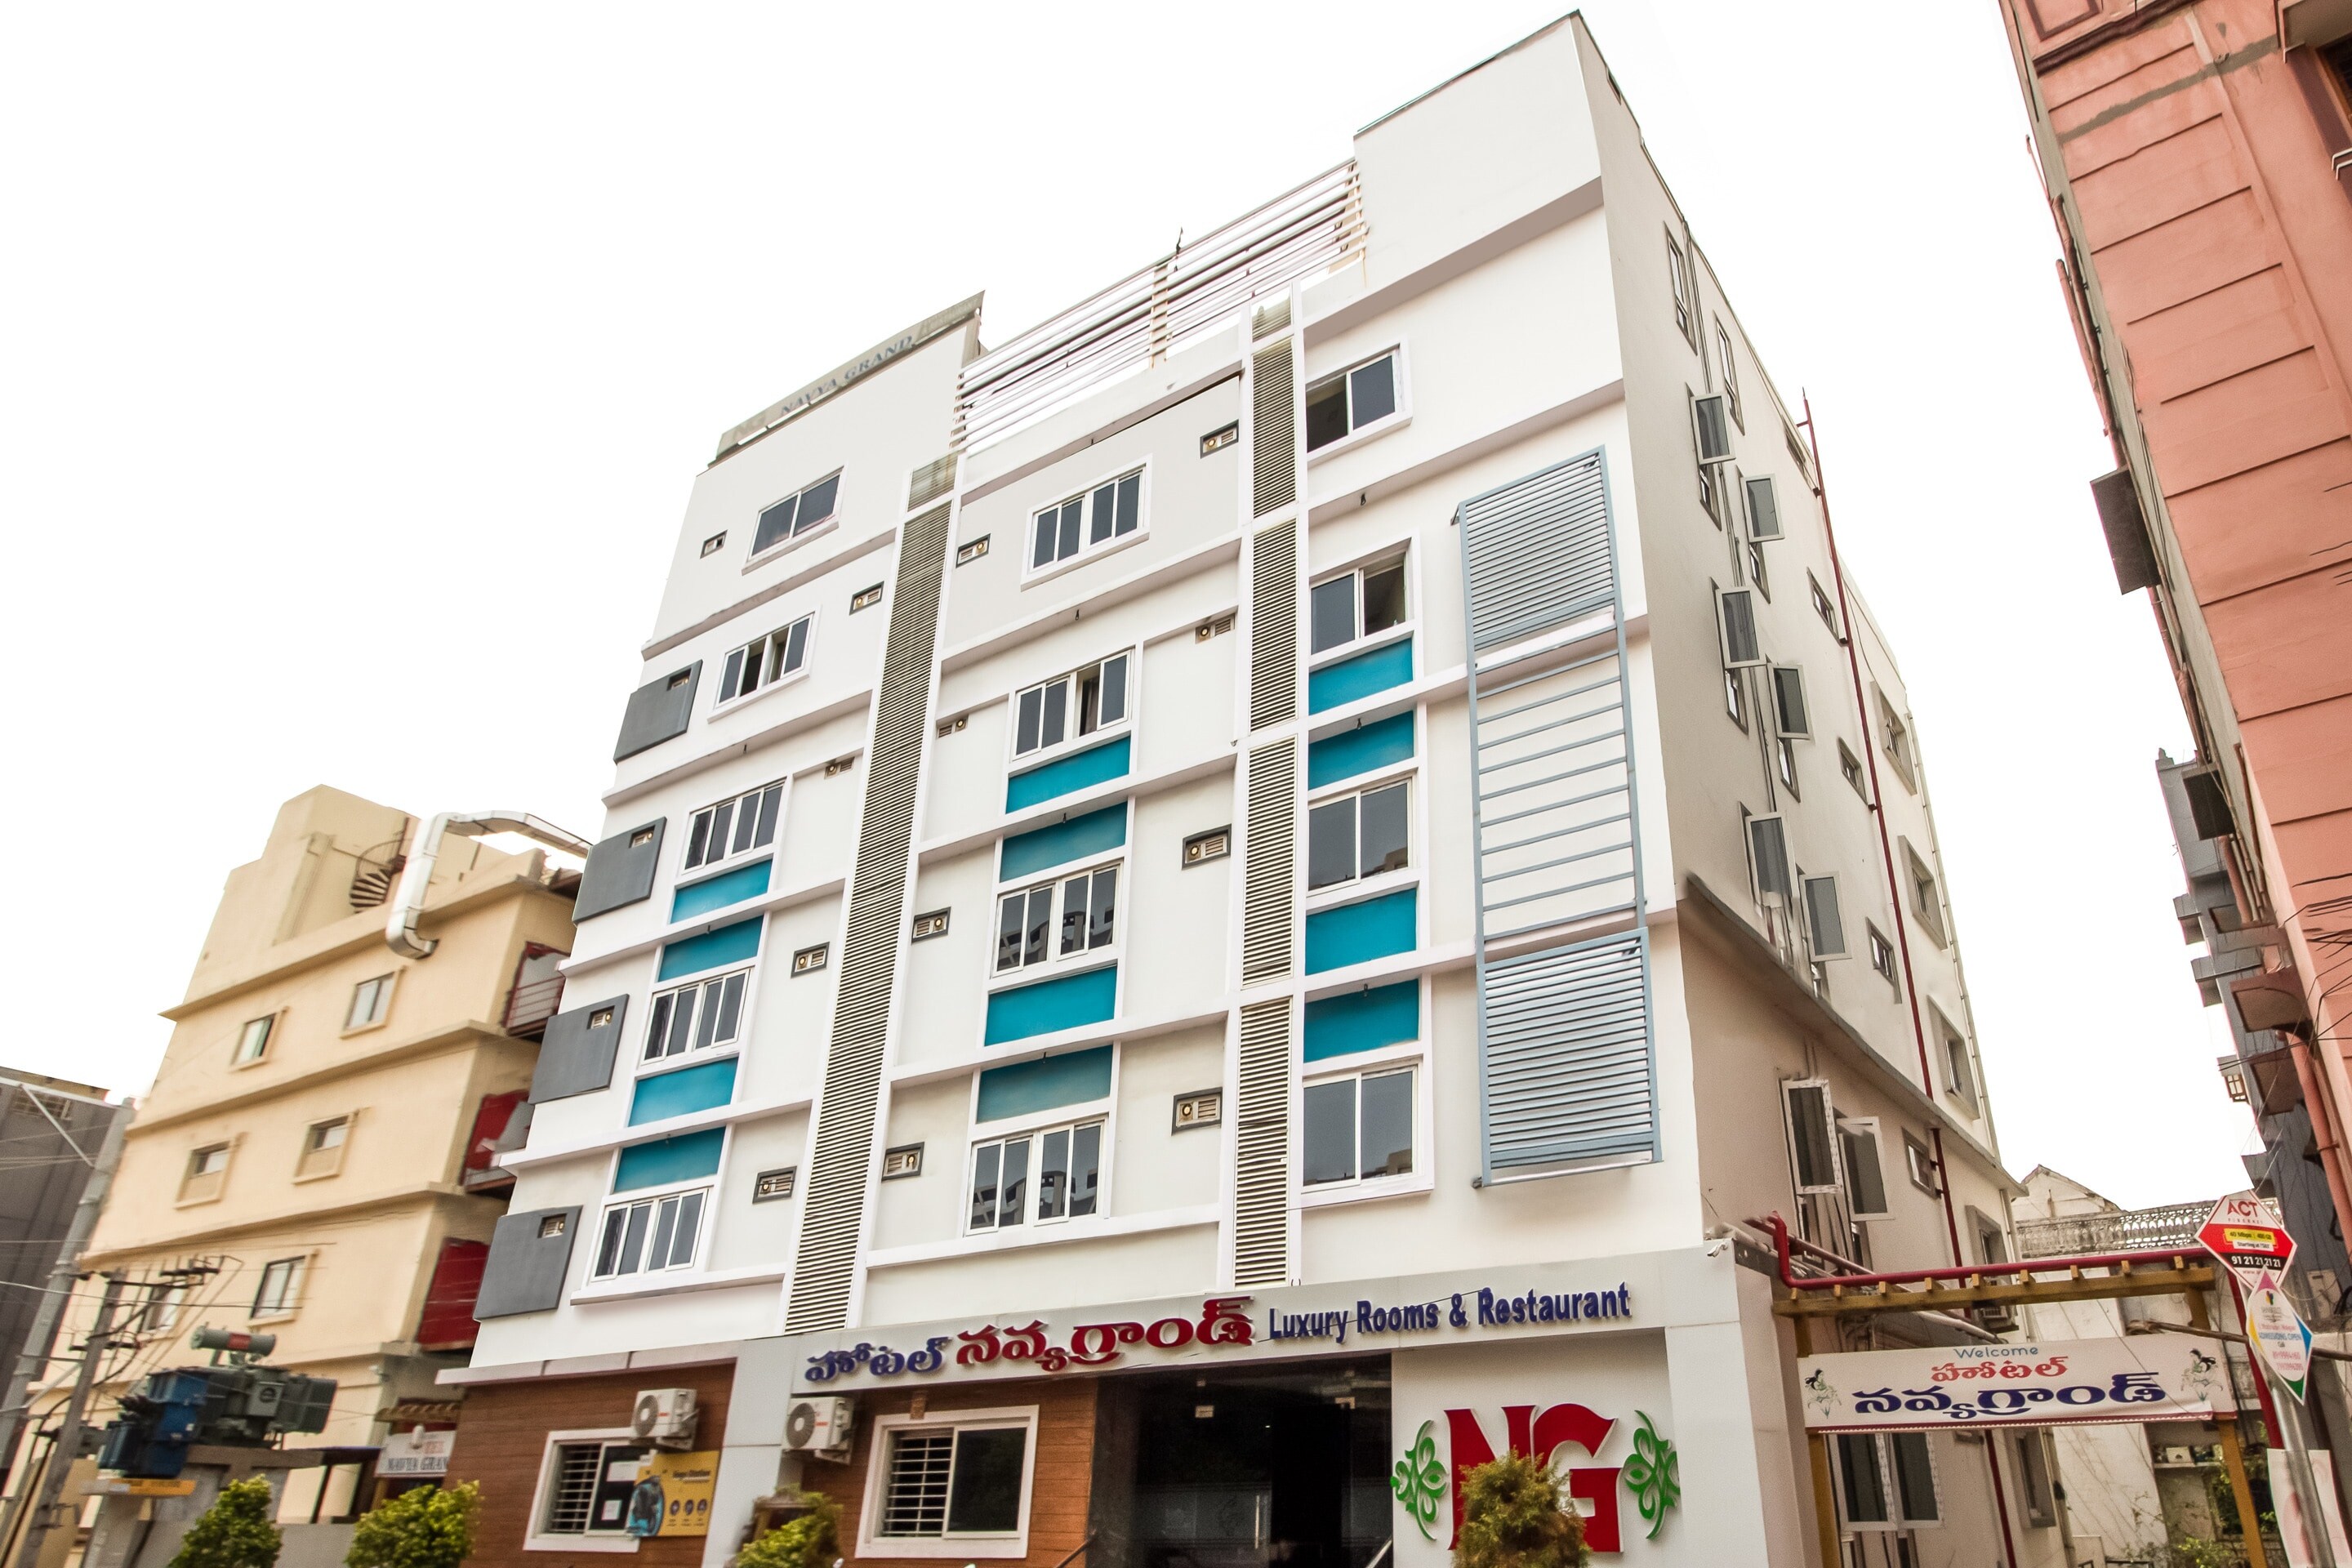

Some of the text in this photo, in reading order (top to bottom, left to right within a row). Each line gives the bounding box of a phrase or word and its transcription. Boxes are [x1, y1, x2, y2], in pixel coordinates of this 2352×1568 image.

[780, 378, 836, 416] NAVYA
[844, 336, 913, 381] GRAND
[2228, 1201, 2257, 1217] ACT
[2231, 1256, 2281, 1267] 91 21 21 21 21
[1269, 1281, 1632, 1343] Luxury Rooms & Restaurant
[805, 1336, 952, 1382] హోటల్
[1931, 1356, 2069, 1383] హోటల్
[1953, 1346, 2039, 1361] Welcome
[1444, 1403, 1624, 1553] NG
